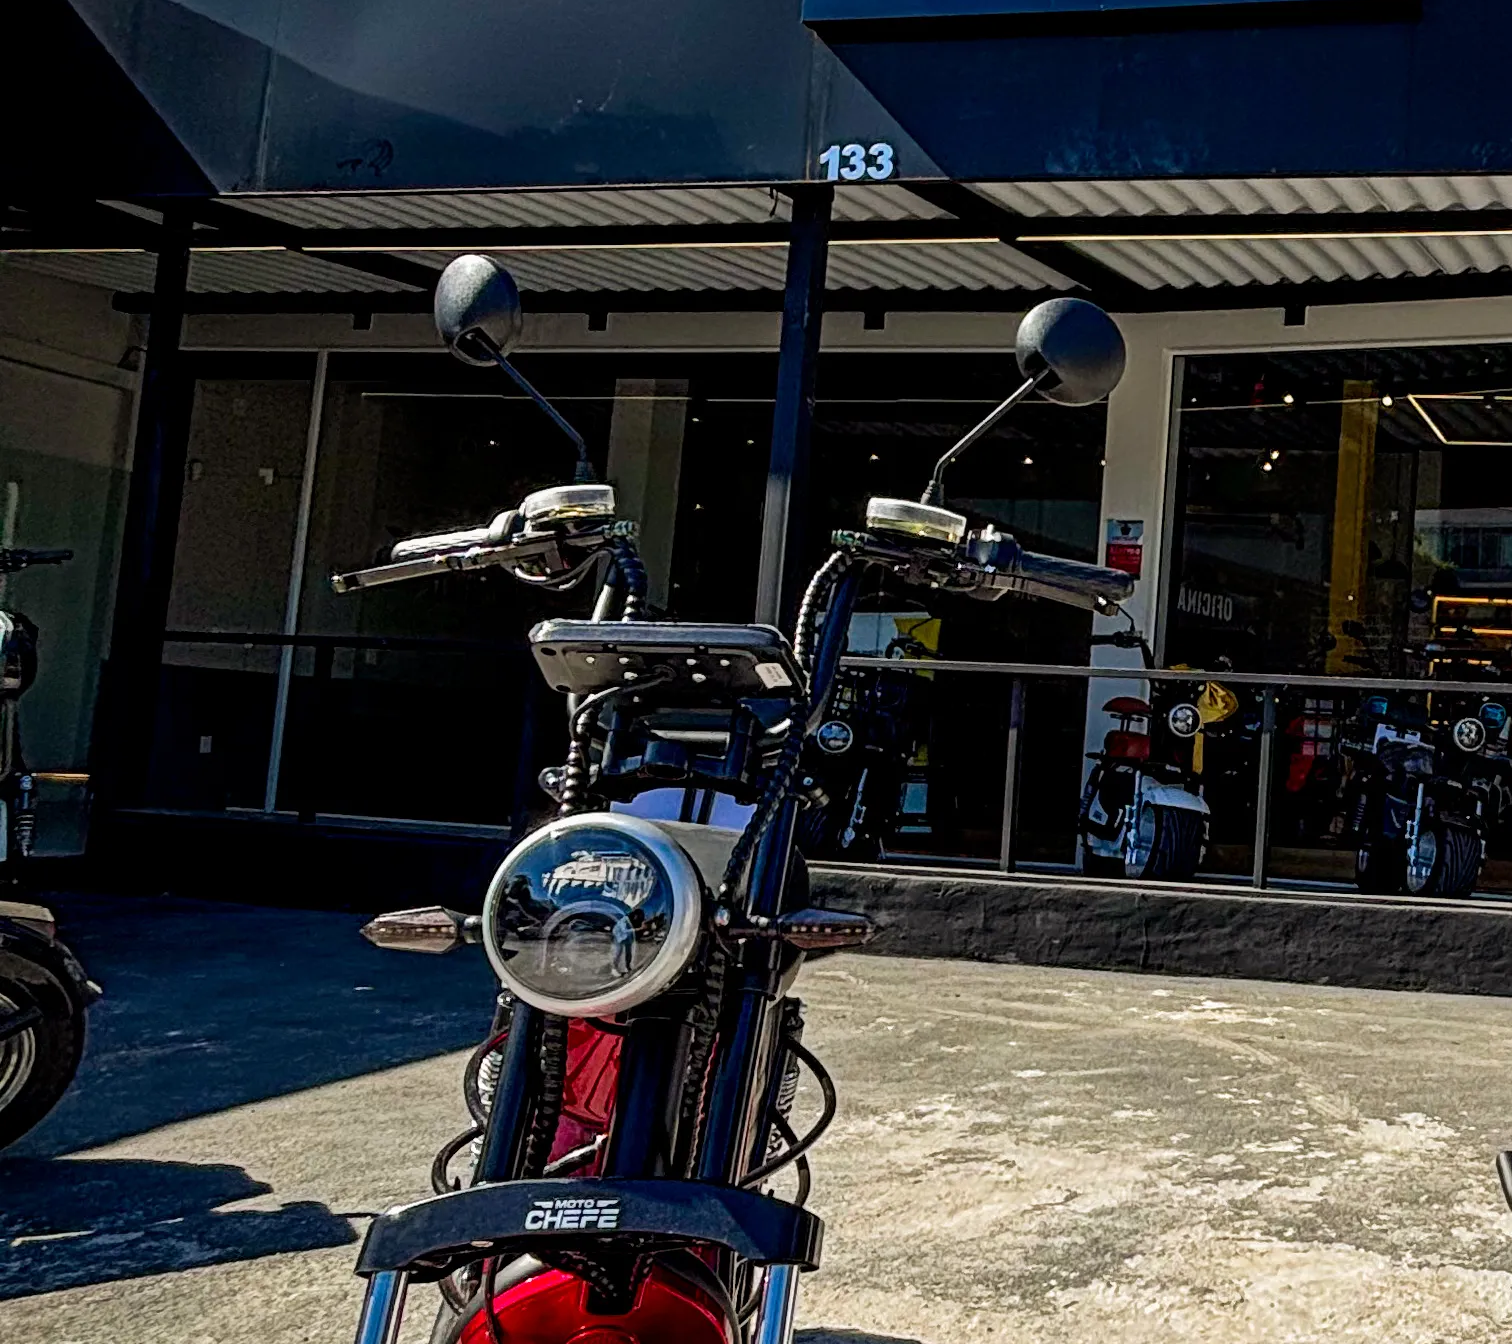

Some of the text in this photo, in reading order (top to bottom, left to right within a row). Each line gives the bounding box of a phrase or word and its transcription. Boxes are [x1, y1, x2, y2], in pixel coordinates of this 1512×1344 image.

[820, 142, 893, 181] 133
[555, 1199, 594, 1209] MOTO
[525, 1209, 619, 1230] CHEFE
